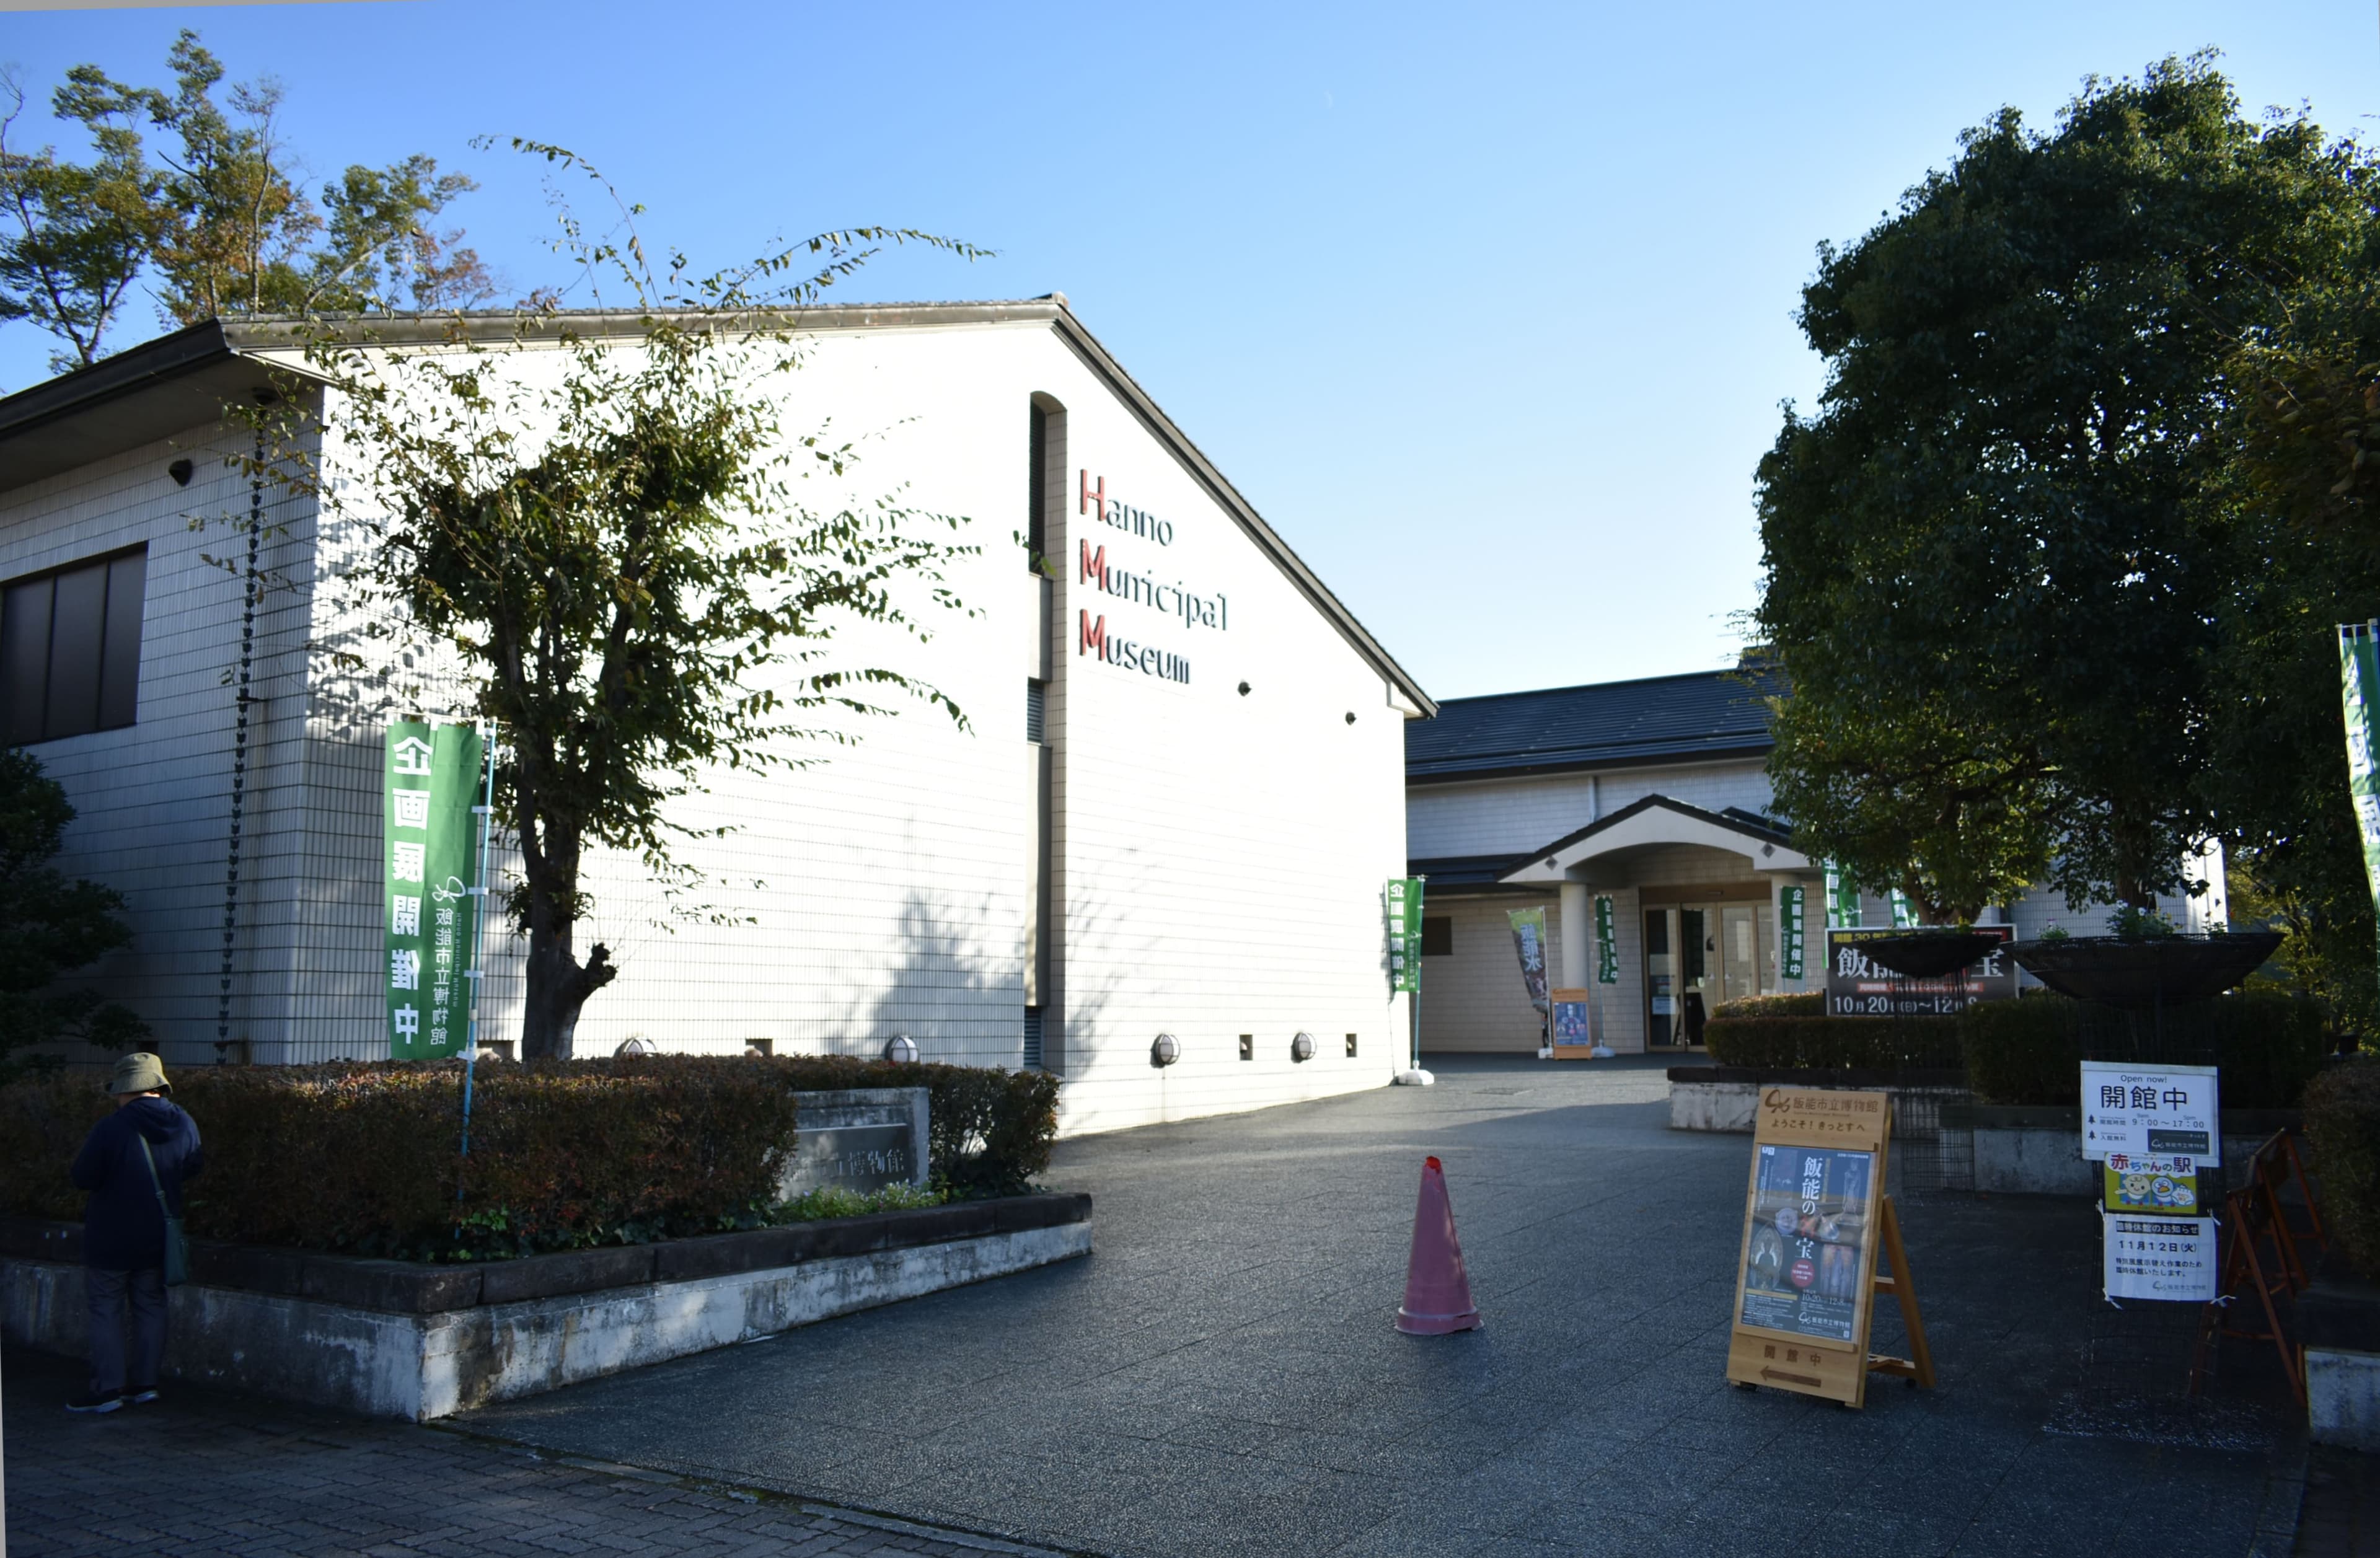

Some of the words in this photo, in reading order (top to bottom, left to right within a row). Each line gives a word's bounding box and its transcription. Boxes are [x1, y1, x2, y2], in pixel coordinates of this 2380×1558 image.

[1080, 469, 1173, 547] Hanno
[1080, 538, 1227, 631] Municipal
[1080, 609, 1191, 685] Museum
[2120, 1075, 2143, 1085] Open
[2147, 1076, 2167, 1084] now!
[1793, 1097, 1879, 1113] 飯能市立博物館
[2100, 1085, 2188, 1111] 開館中
[2110, 1154, 2192, 1173] 赤ちゃんの駅
[2117, 1221, 2199, 1235] 臨時休館のお知らせ
[2119, 1241, 2197, 1253] 11月12日(火)
[1764, 1345, 1822, 1367] 開館中
